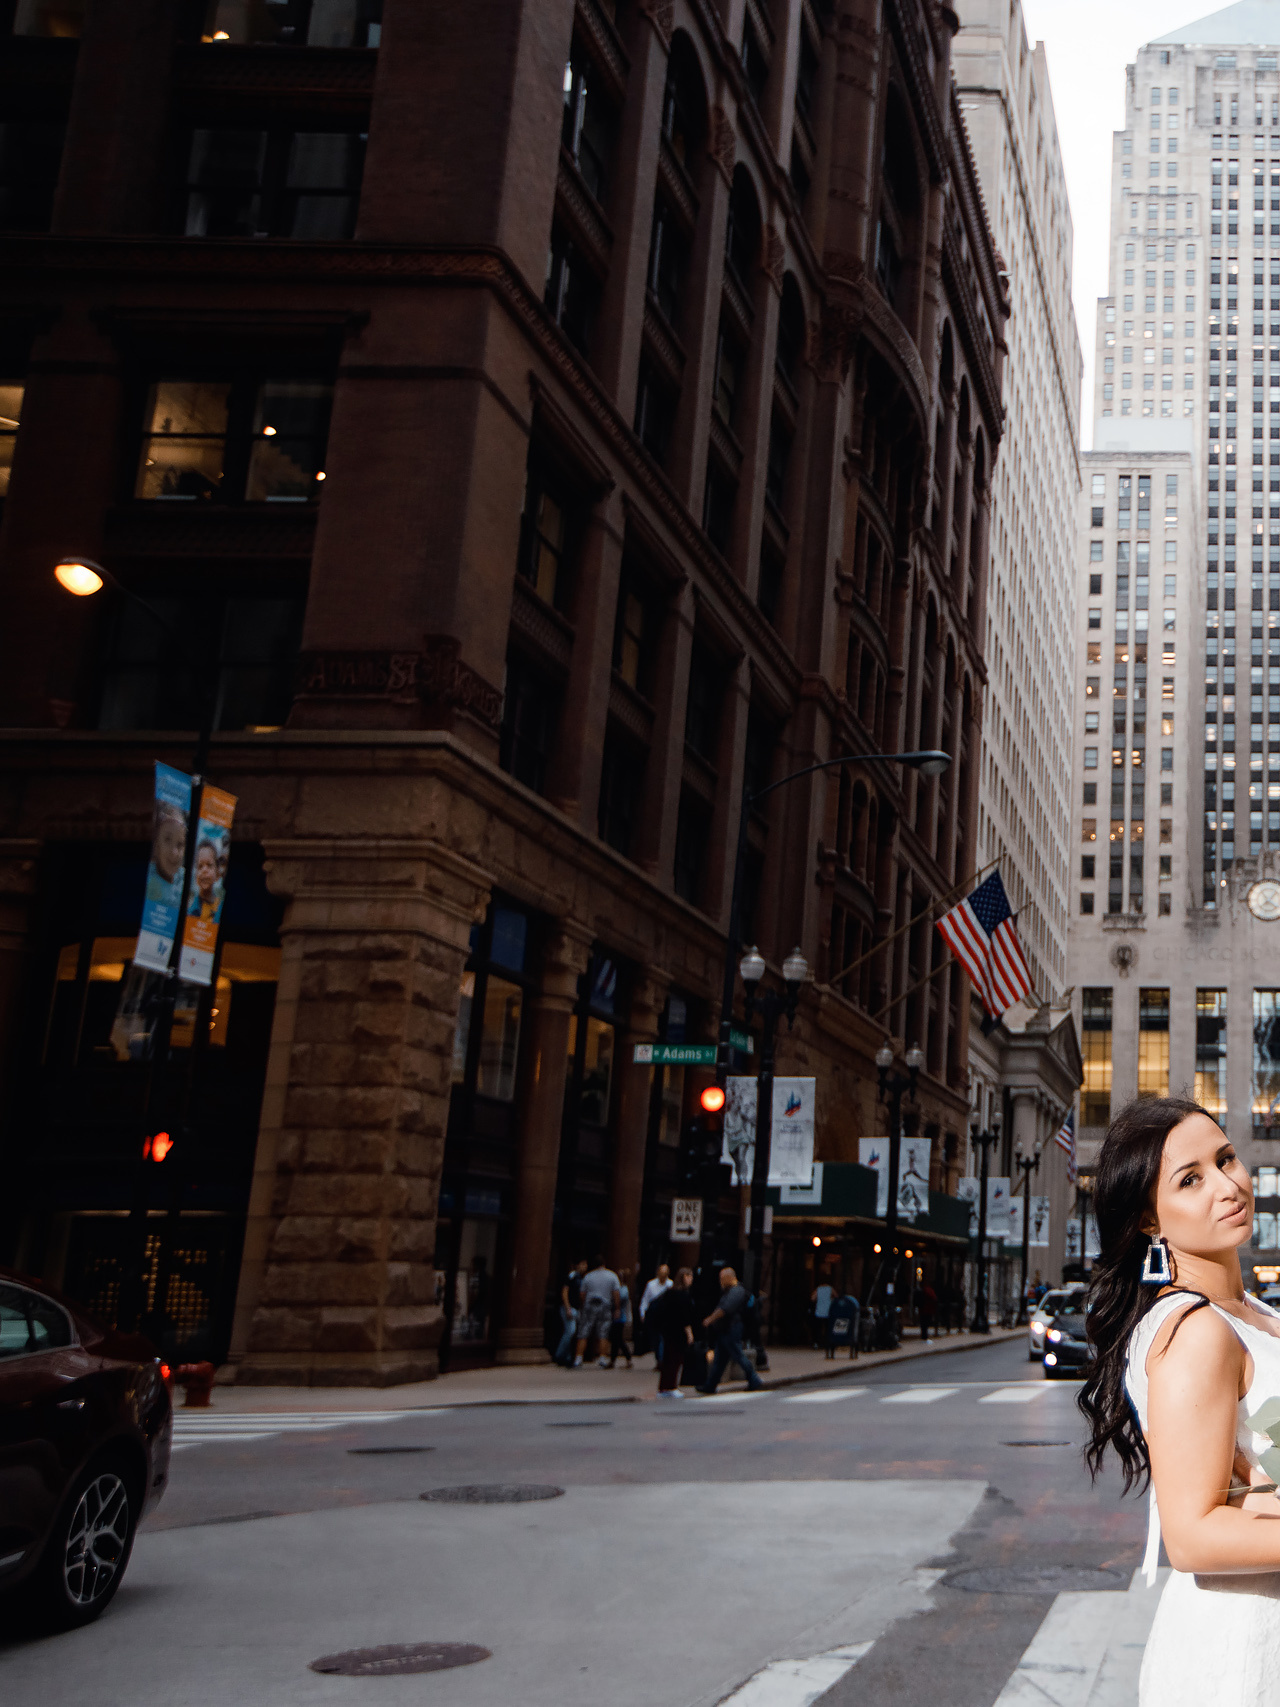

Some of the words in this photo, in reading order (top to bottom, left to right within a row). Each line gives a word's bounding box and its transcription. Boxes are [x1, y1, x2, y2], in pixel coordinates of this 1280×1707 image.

[1153, 947, 1233, 961] CHICAGO
[663, 1046, 702, 1060] Adams
[677, 1201, 699, 1212] ONE
[676, 1213, 697, 1224] WAY
